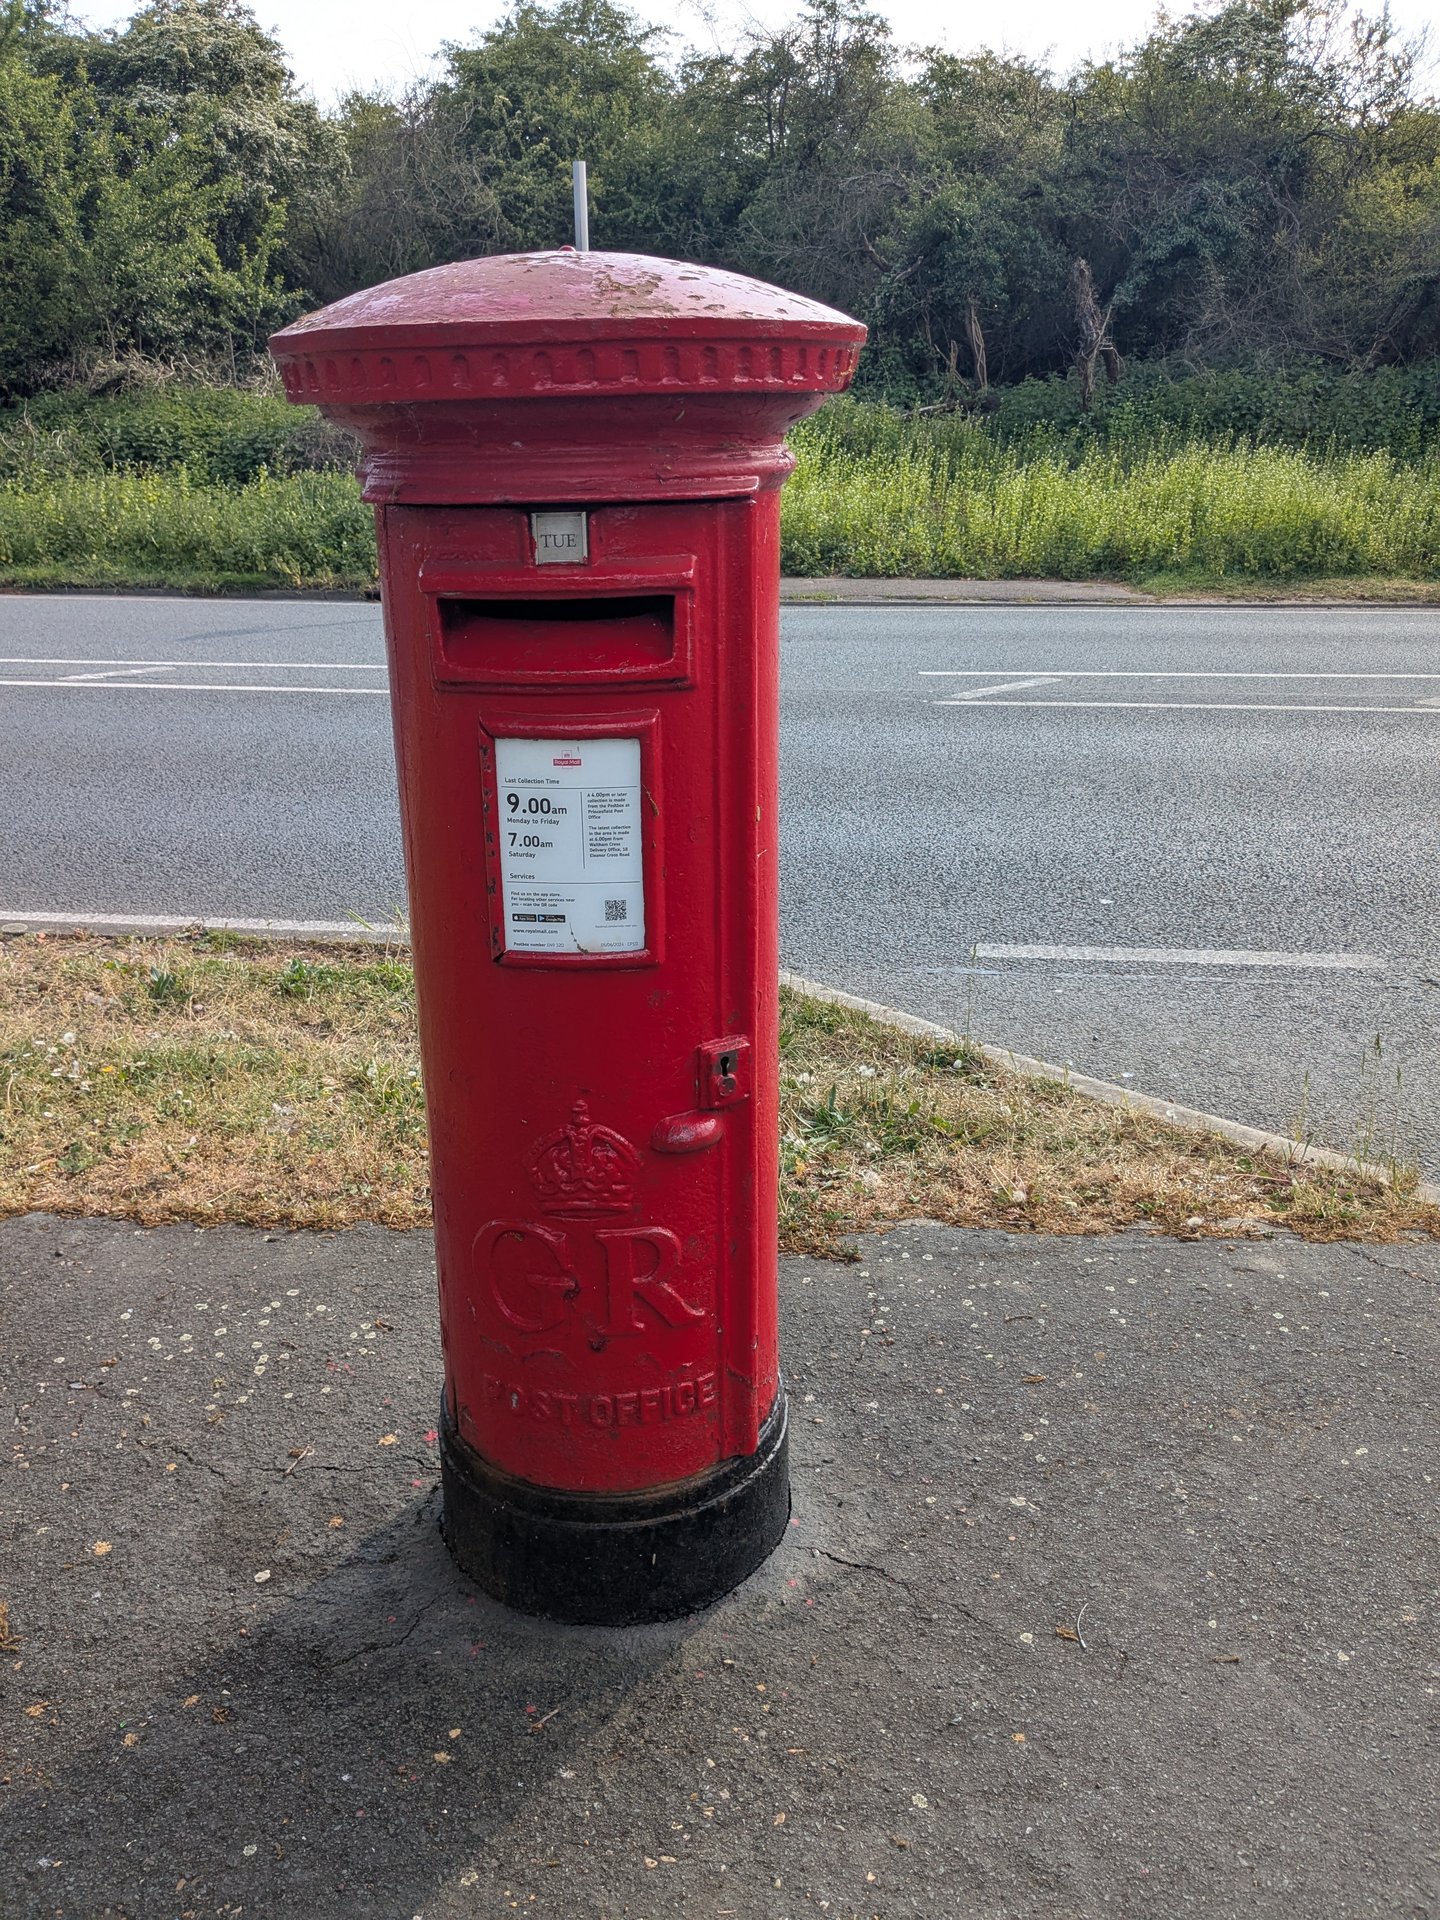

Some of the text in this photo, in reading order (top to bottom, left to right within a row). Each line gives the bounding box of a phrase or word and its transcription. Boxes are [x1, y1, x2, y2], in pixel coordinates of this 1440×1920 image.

[540, 534, 577, 548] TUE
[517, 777, 545, 785] Collection
[506, 792, 568, 815] 9.00am
[506, 817, 531, 825] Monday
[540, 818, 560, 826] Friday
[508, 832, 553, 848] 7.00am
[508, 851, 537, 859] Saturday
[484, 1372, 720, 1428] POST OFFICE
